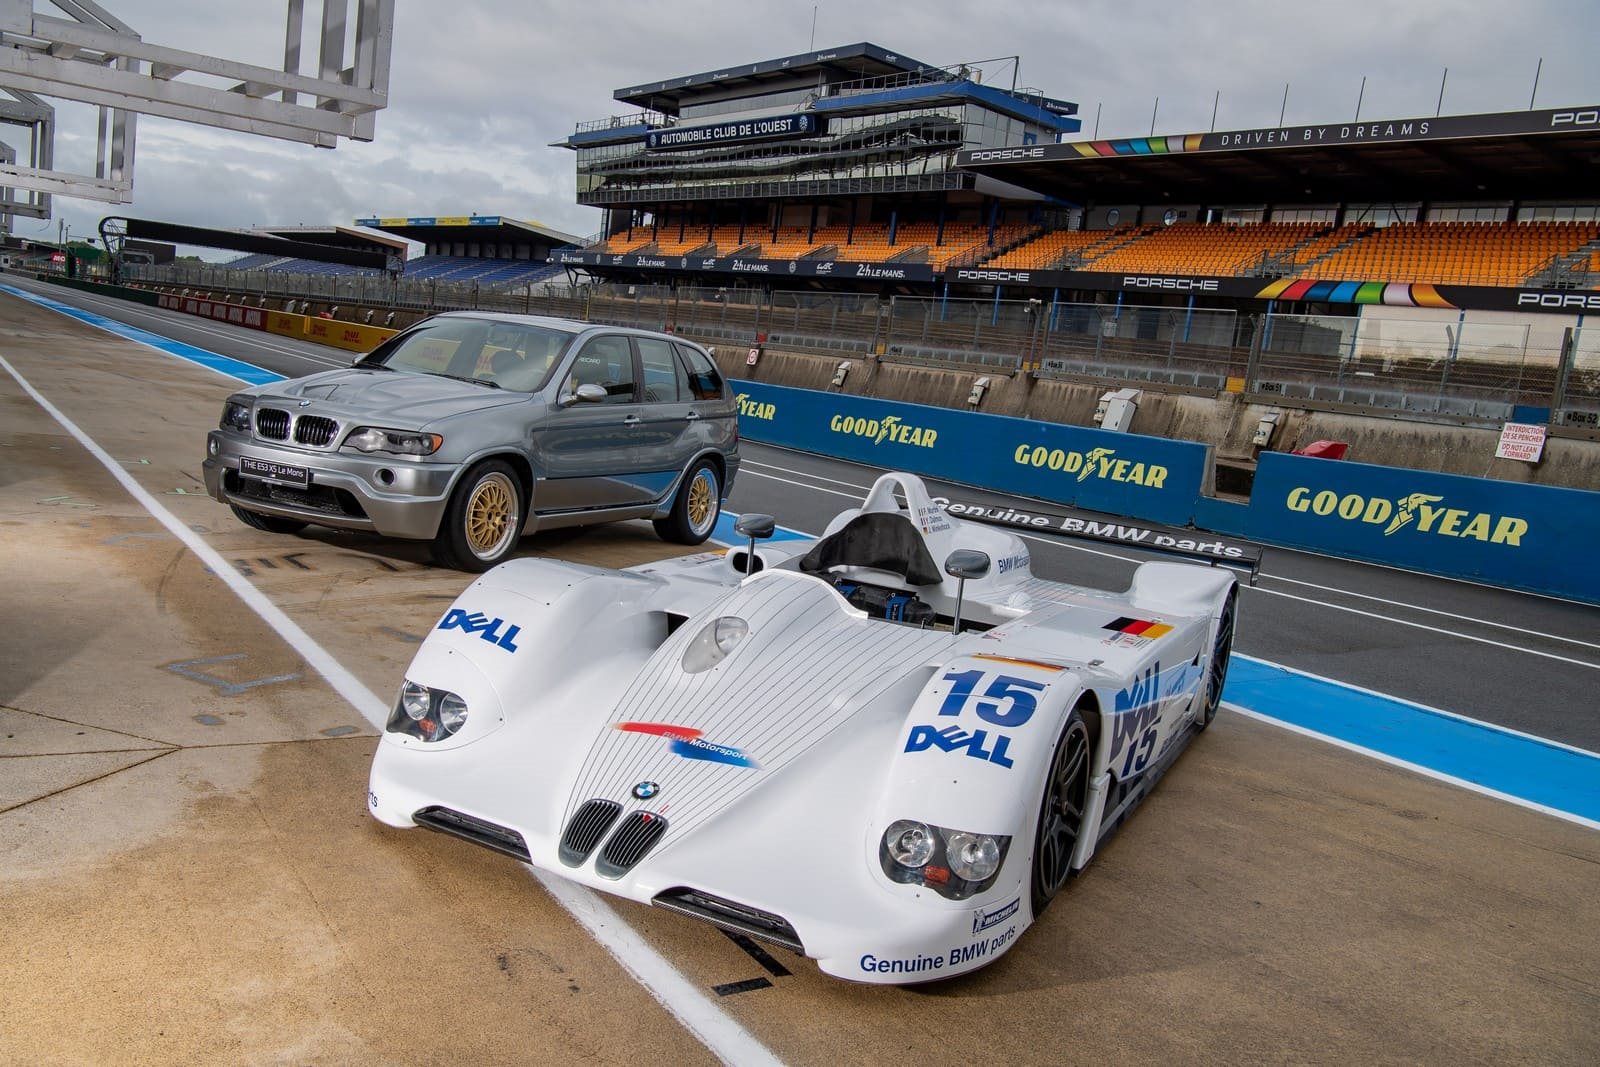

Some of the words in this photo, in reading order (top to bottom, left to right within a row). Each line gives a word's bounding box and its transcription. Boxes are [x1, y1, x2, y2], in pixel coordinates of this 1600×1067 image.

[1551, 111, 1600, 126] PO
[661, 129, 712, 145] AUTOMOBILE
[714, 127, 737, 138] CLUB
[739, 125, 752, 136] DE
[754, 119, 793, 134] L'OUEST
[1221, 130, 1290, 146] DRIVEN
[1303, 128, 1327, 140] BY
[1340, 122, 1430, 139] DREAMS
[971, 148, 1045, 161] PORSCHE
[751, 264, 768, 272] MANS
[871, 269, 882, 277] LE
[882, 269, 904, 278] MANS
[958, 270, 1030, 282] PORSCHE
[1122, 276, 1219, 290] PORSCHE
[830, 414, 938, 448] GOODYEAR
[1506, 425, 1545, 435] INTERDICTION
[1518, 434, 1543, 443] PENCHER
[1503, 450, 1531, 459] FORWARD
[1523, 445, 1537, 453] LEAN
[244, 460, 257, 470] THE
[257, 463, 269, 472] E53
[278, 466, 286, 475] Le
[1014, 444, 1168, 488] GOODYEAR
[1286, 487, 1529, 547] GOODYEAR
[930, 497, 1050, 526] Genuine
[1059, 517, 1149, 543] BMW
[1152, 534, 1243, 558] parts
[998, 557, 1013, 574] BMW
[438, 608, 521, 654] DELL
[938, 670, 1046, 728] 15
[904, 725, 1014, 769] DELL
[1121, 715, 1162, 778] 15
[985, 900, 1019, 925] MICHELIN
[860, 954, 944, 973] Genuine
[950, 938, 989, 966] BMW
[991, 925, 1015, 955] parts
